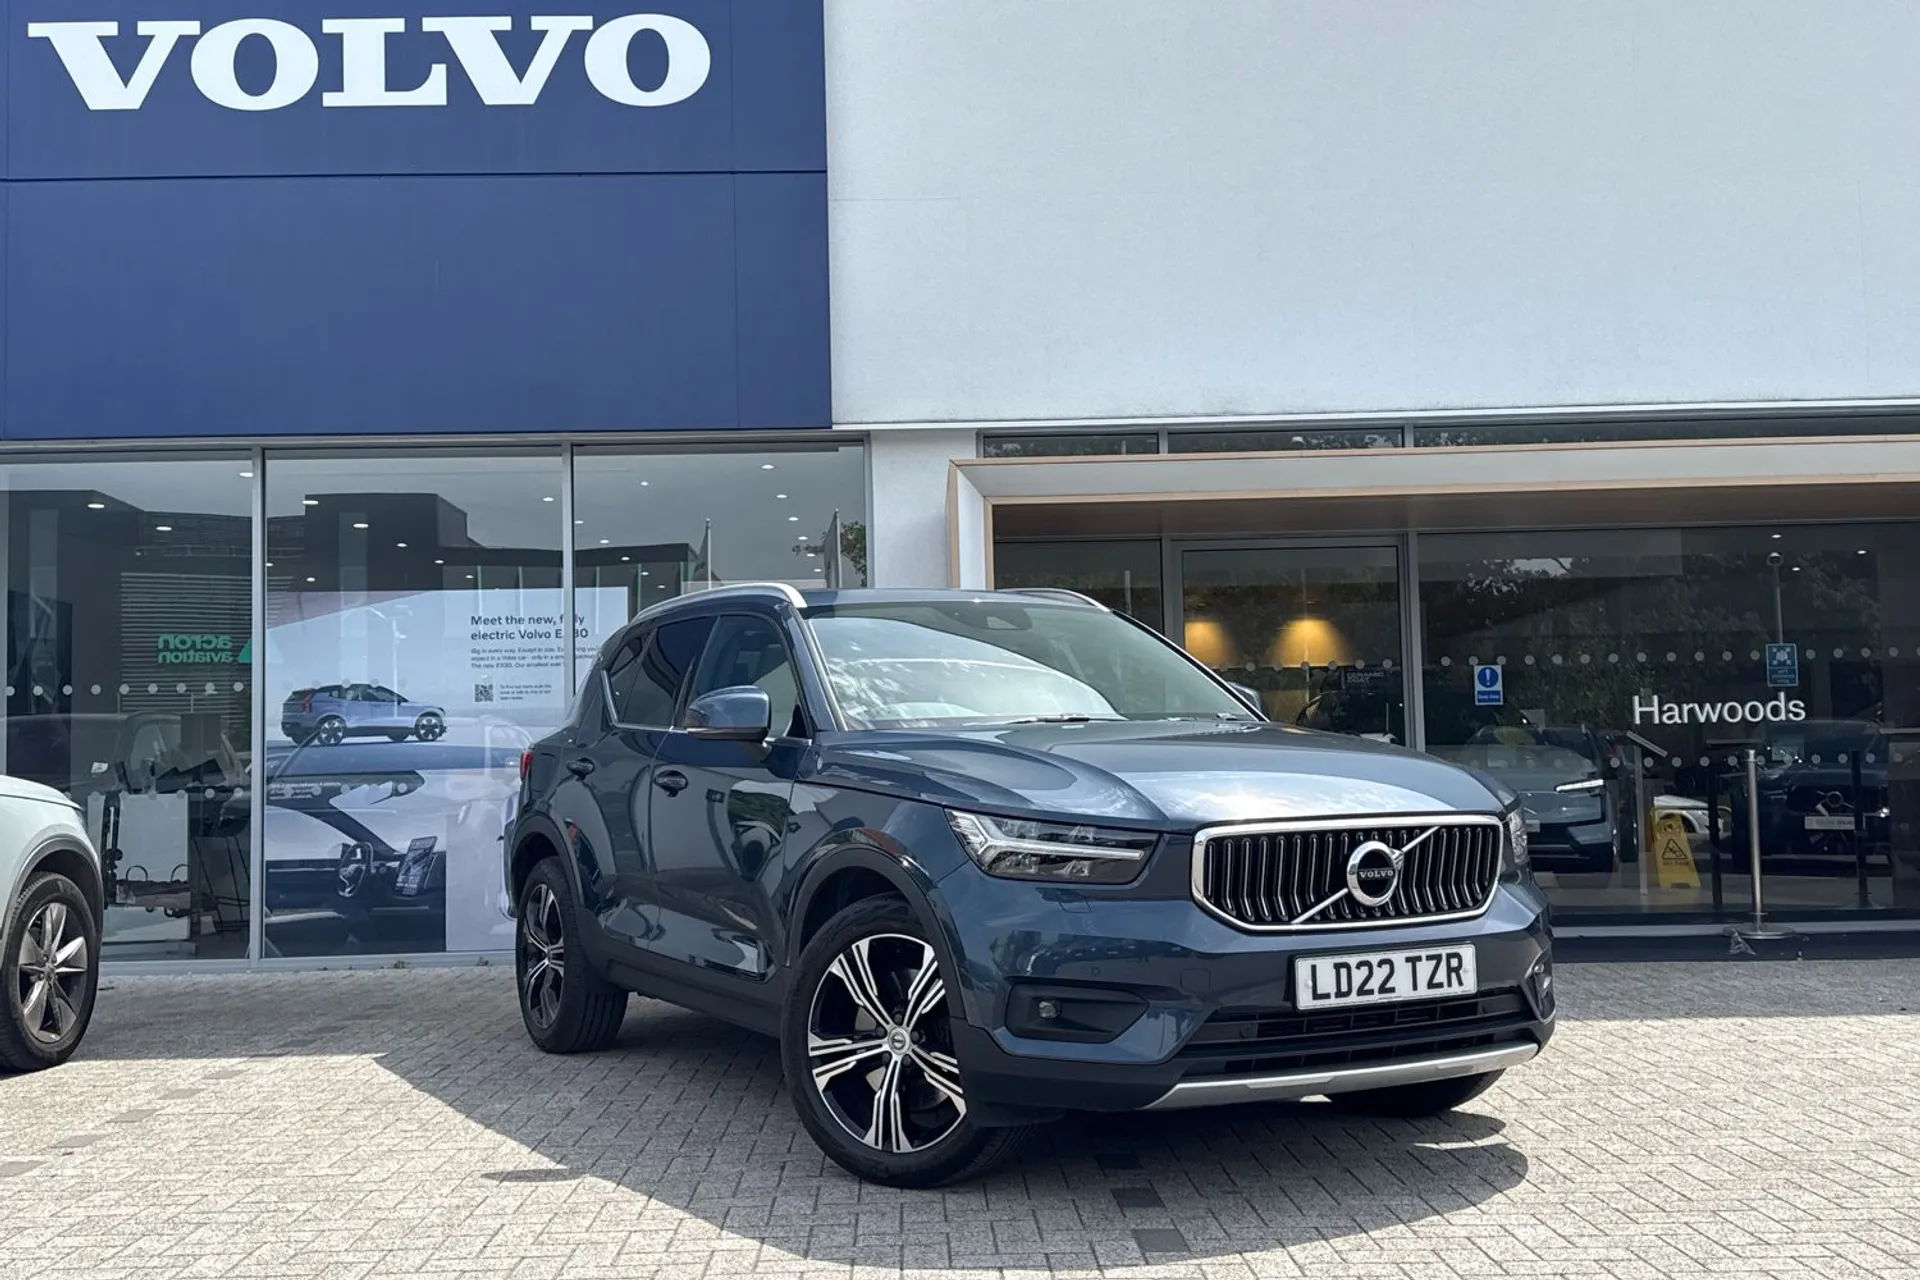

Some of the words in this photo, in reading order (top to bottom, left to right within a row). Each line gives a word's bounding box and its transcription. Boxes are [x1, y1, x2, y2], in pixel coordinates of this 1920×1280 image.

[27, 13, 711, 111] VOLVO
[471, 615, 502, 625] Meet
[505, 615, 525, 625] the
[528, 615, 556, 627] new,
[471, 630, 517, 640] electric
[518, 628, 552, 639] Volvo
[555, 628, 589, 639] E30
[1632, 691, 1806, 725] Harwoods
[1358, 868, 1394, 879] VOLVO
[1310, 958, 1396, 1001] LD22
[1405, 952, 1464, 992] TZR
